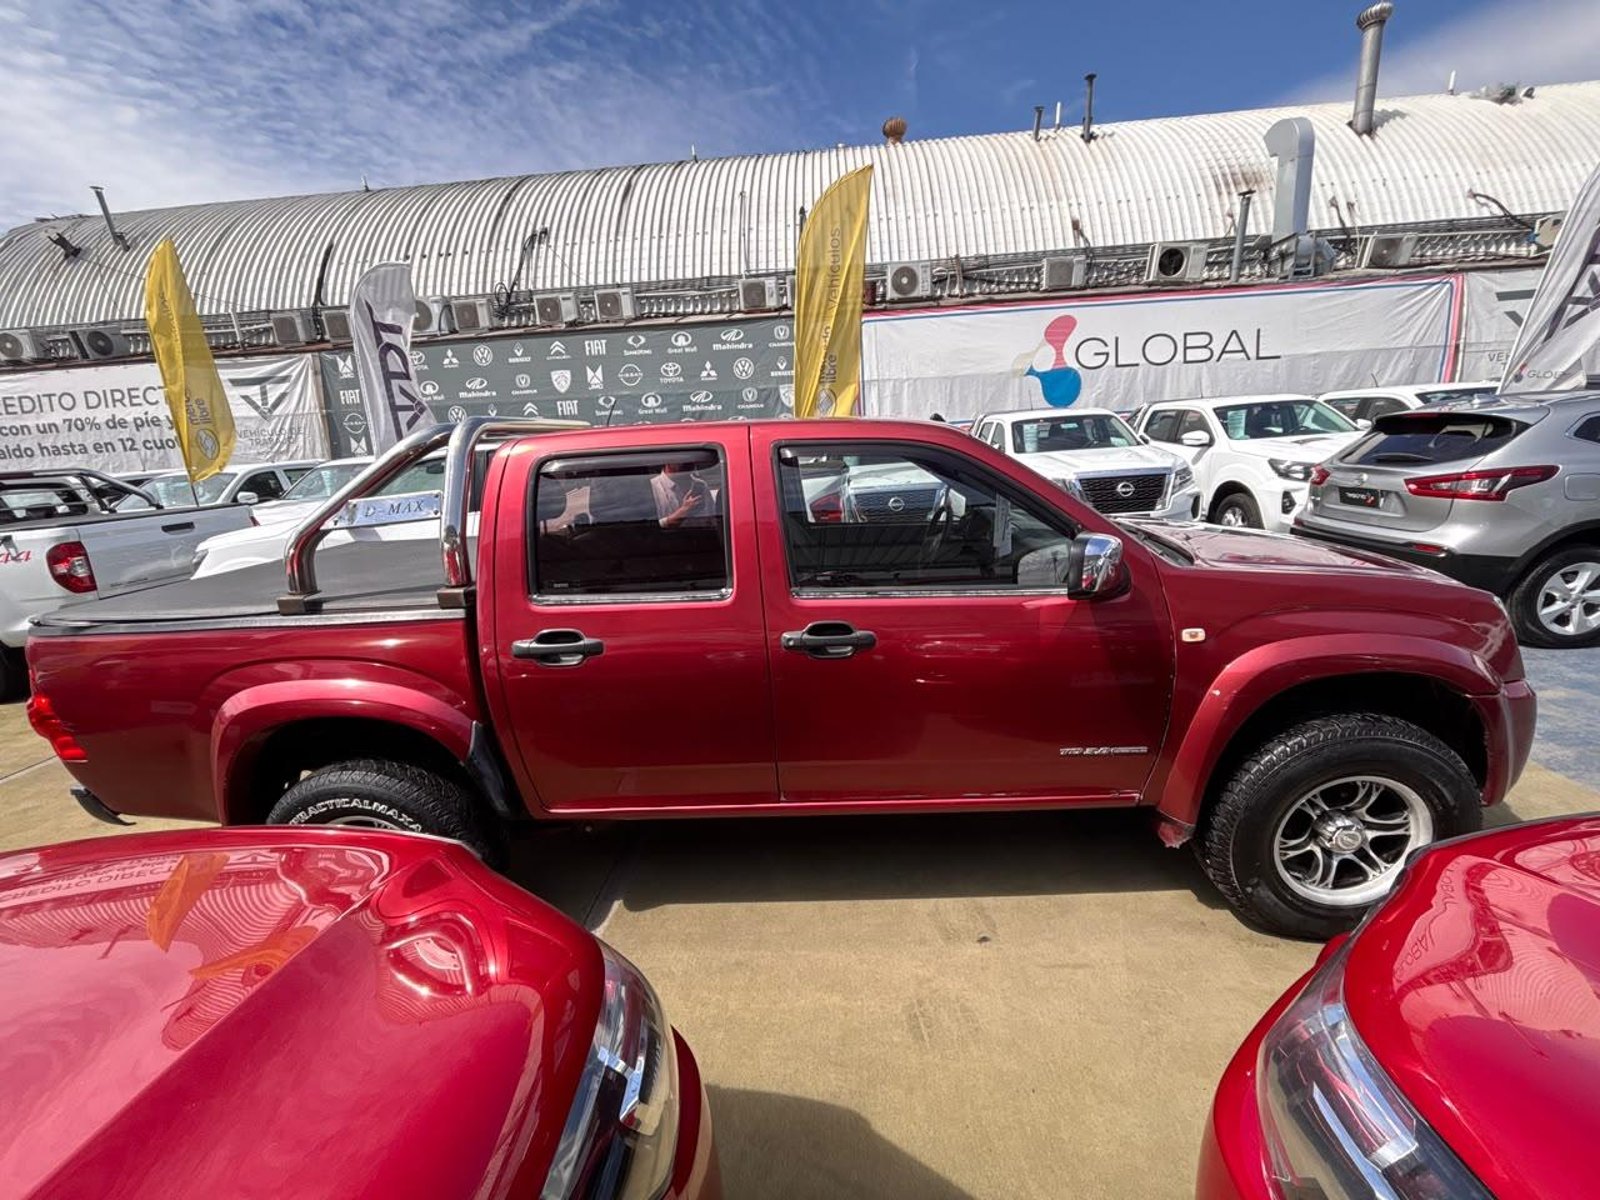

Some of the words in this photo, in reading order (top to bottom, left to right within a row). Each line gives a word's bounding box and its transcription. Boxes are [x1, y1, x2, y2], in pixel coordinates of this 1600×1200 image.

[584, 340, 607, 356] FIAT
[713, 342, 753, 350] Mahindra
[1075, 328, 1281, 370] GLOBAL
[826, 354, 837, 383] libre
[0, 392, 76, 415] EDITO
[83, 386, 169, 410] DIRECT
[340, 389, 360, 405] FIAT
[556, 400, 578, 416] FIAT
[682, 404, 722, 412] Mahindra
[0, 425, 32, 436] con
[36, 422, 60, 434] un
[62, 417, 101, 432] 70%
[105, 414, 128, 429] de
[133, 411, 161, 432] pie
[37, 441, 88, 456] hasta
[93, 441, 116, 453] en
[118, 438, 138, 452] 12
